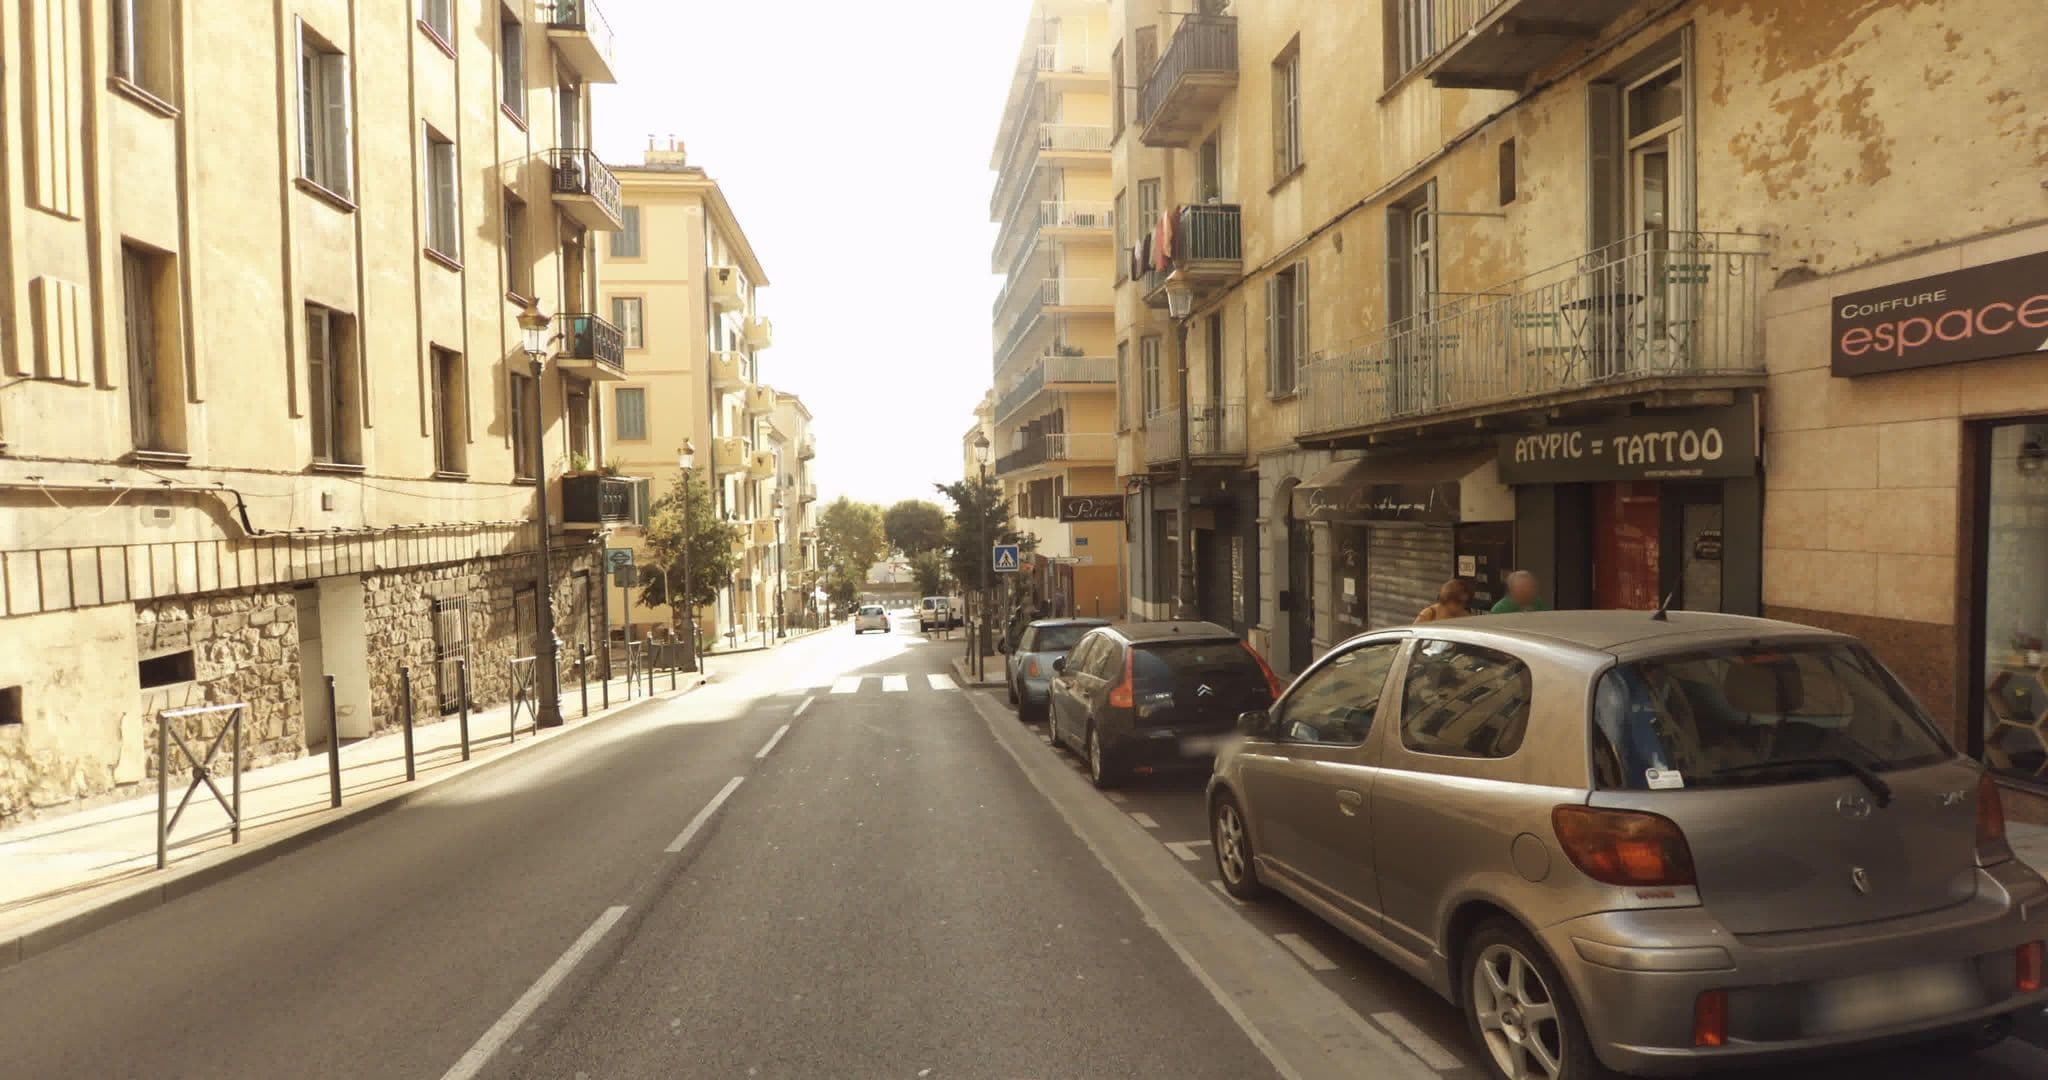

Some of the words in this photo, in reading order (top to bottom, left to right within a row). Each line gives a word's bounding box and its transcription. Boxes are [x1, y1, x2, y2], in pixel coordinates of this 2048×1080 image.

[1840, 294, 2048, 357] espace
[1515, 431, 1583, 463] ATYPIC
[1613, 427, 1724, 465] TATTOO
